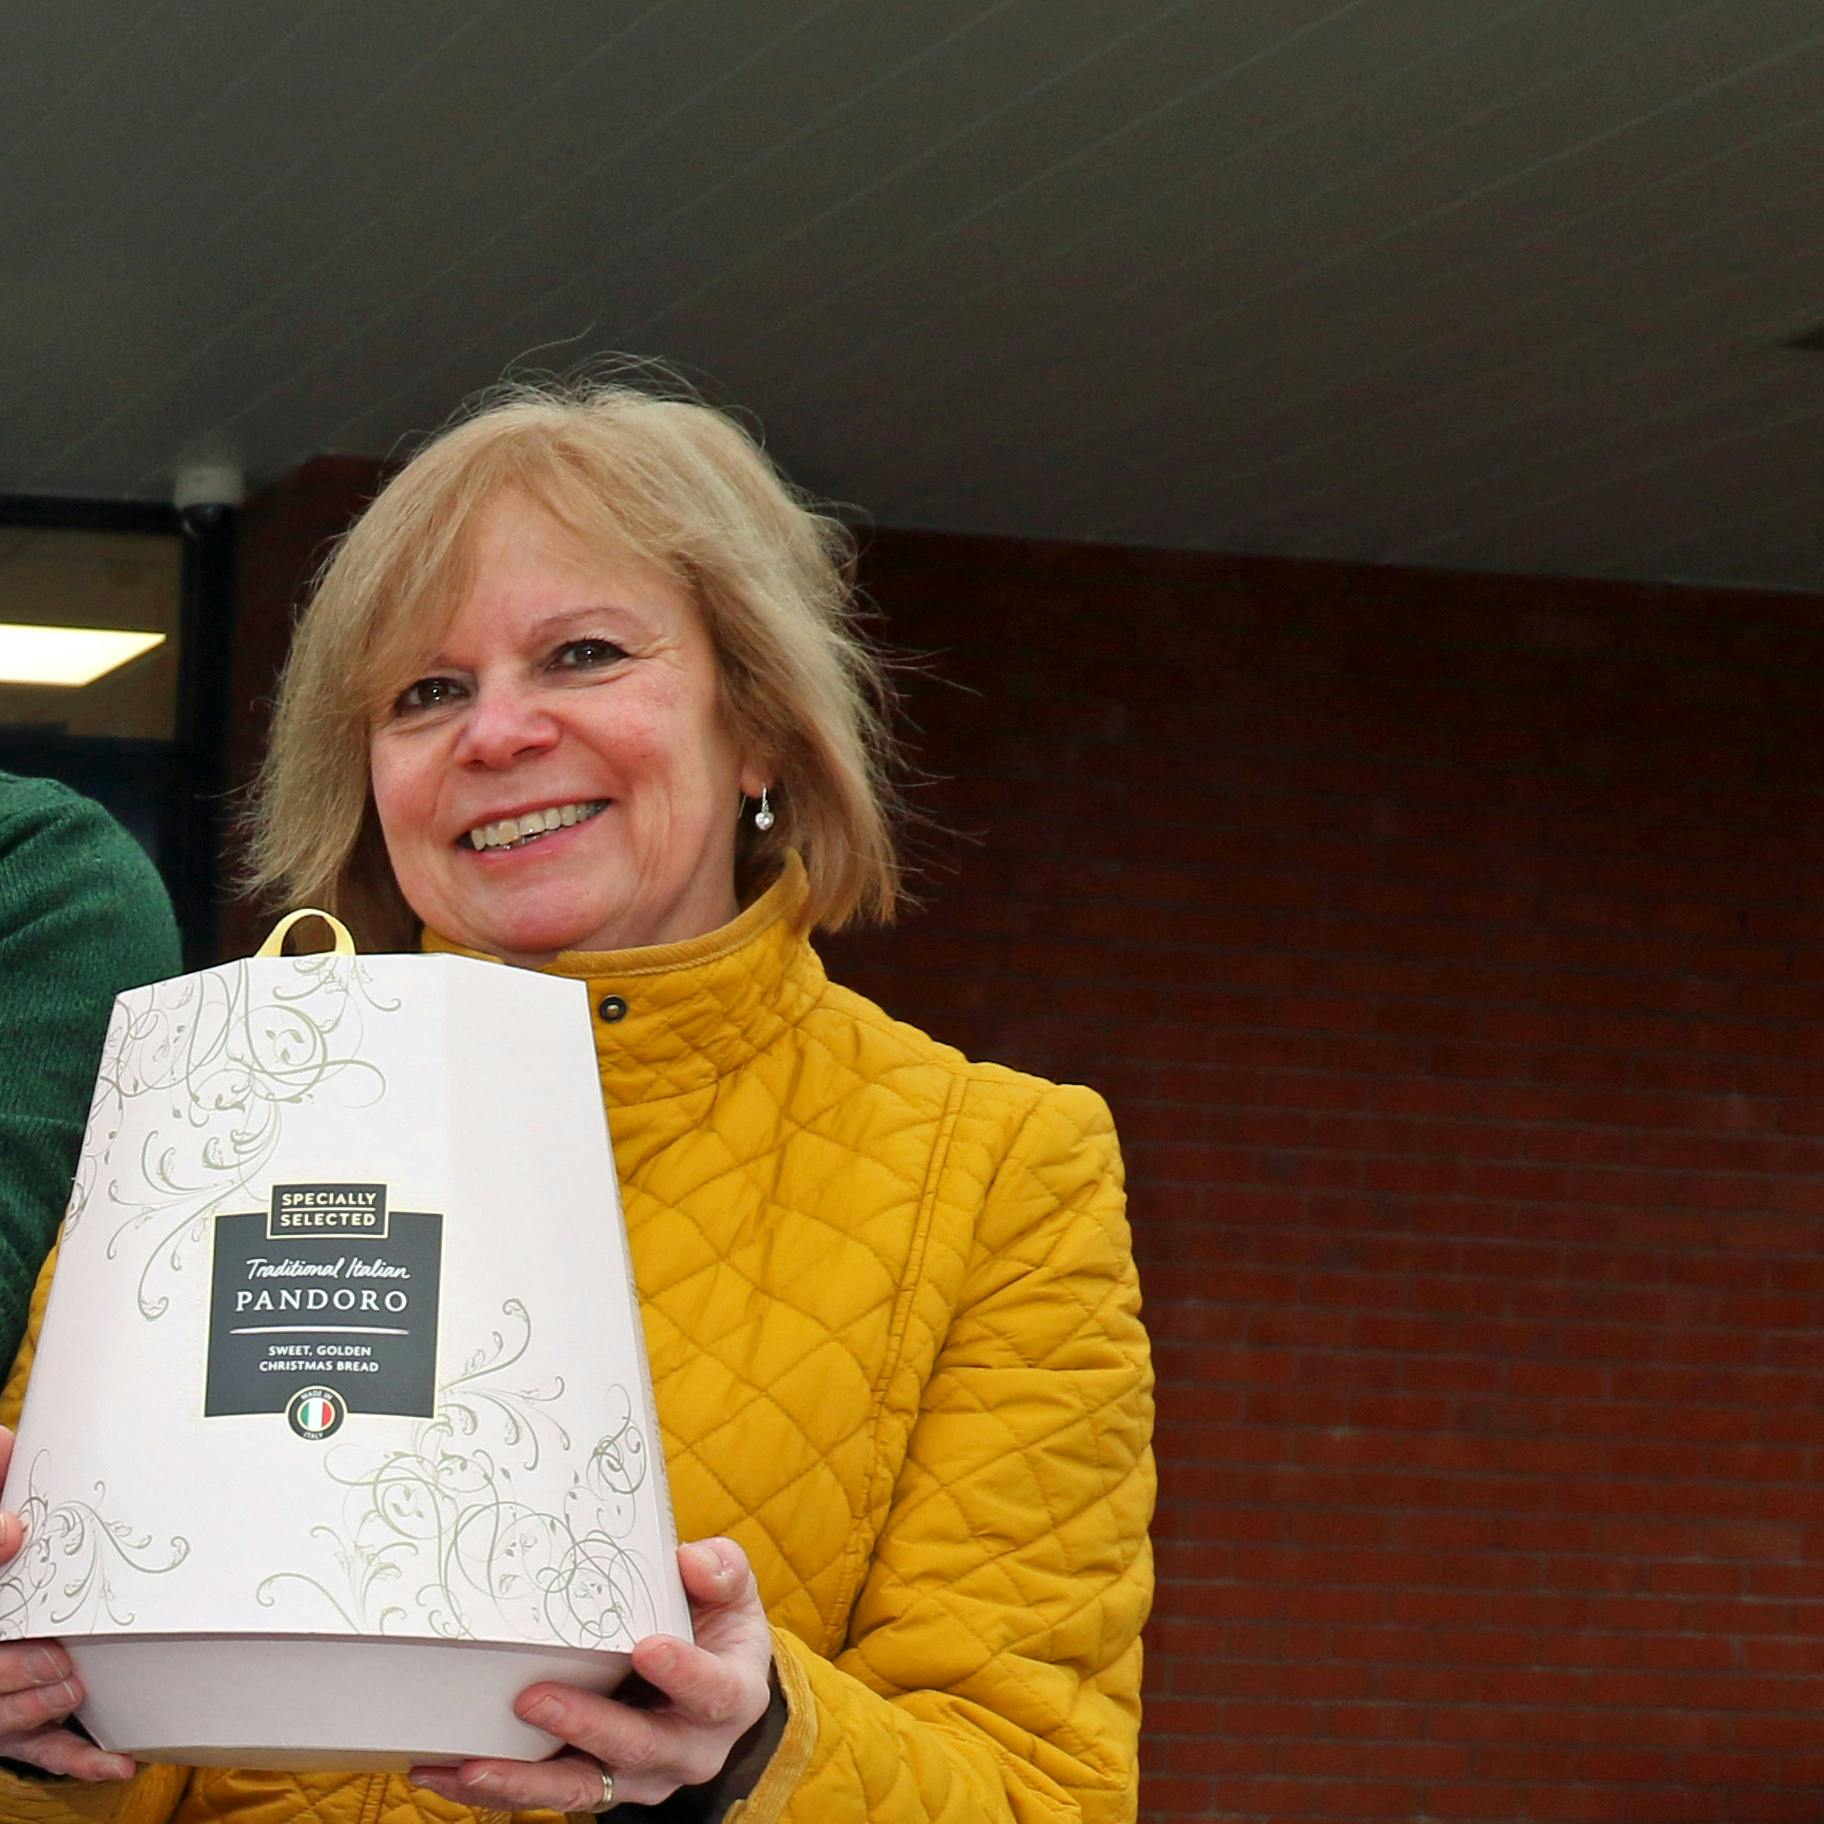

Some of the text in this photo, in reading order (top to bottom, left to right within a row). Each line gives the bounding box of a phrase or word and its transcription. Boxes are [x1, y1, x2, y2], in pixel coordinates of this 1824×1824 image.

[280, 1192, 377, 1207] SPECIALLY
[279, 1212, 376, 1227] SELECTED
[246, 1257, 411, 1280] Traditional Italian
[234, 1288, 409, 1313] PANDORO
[316, 1345, 371, 1357] GOLDEN
[258, 1360, 379, 1373] CHRISTMAS BREAD
